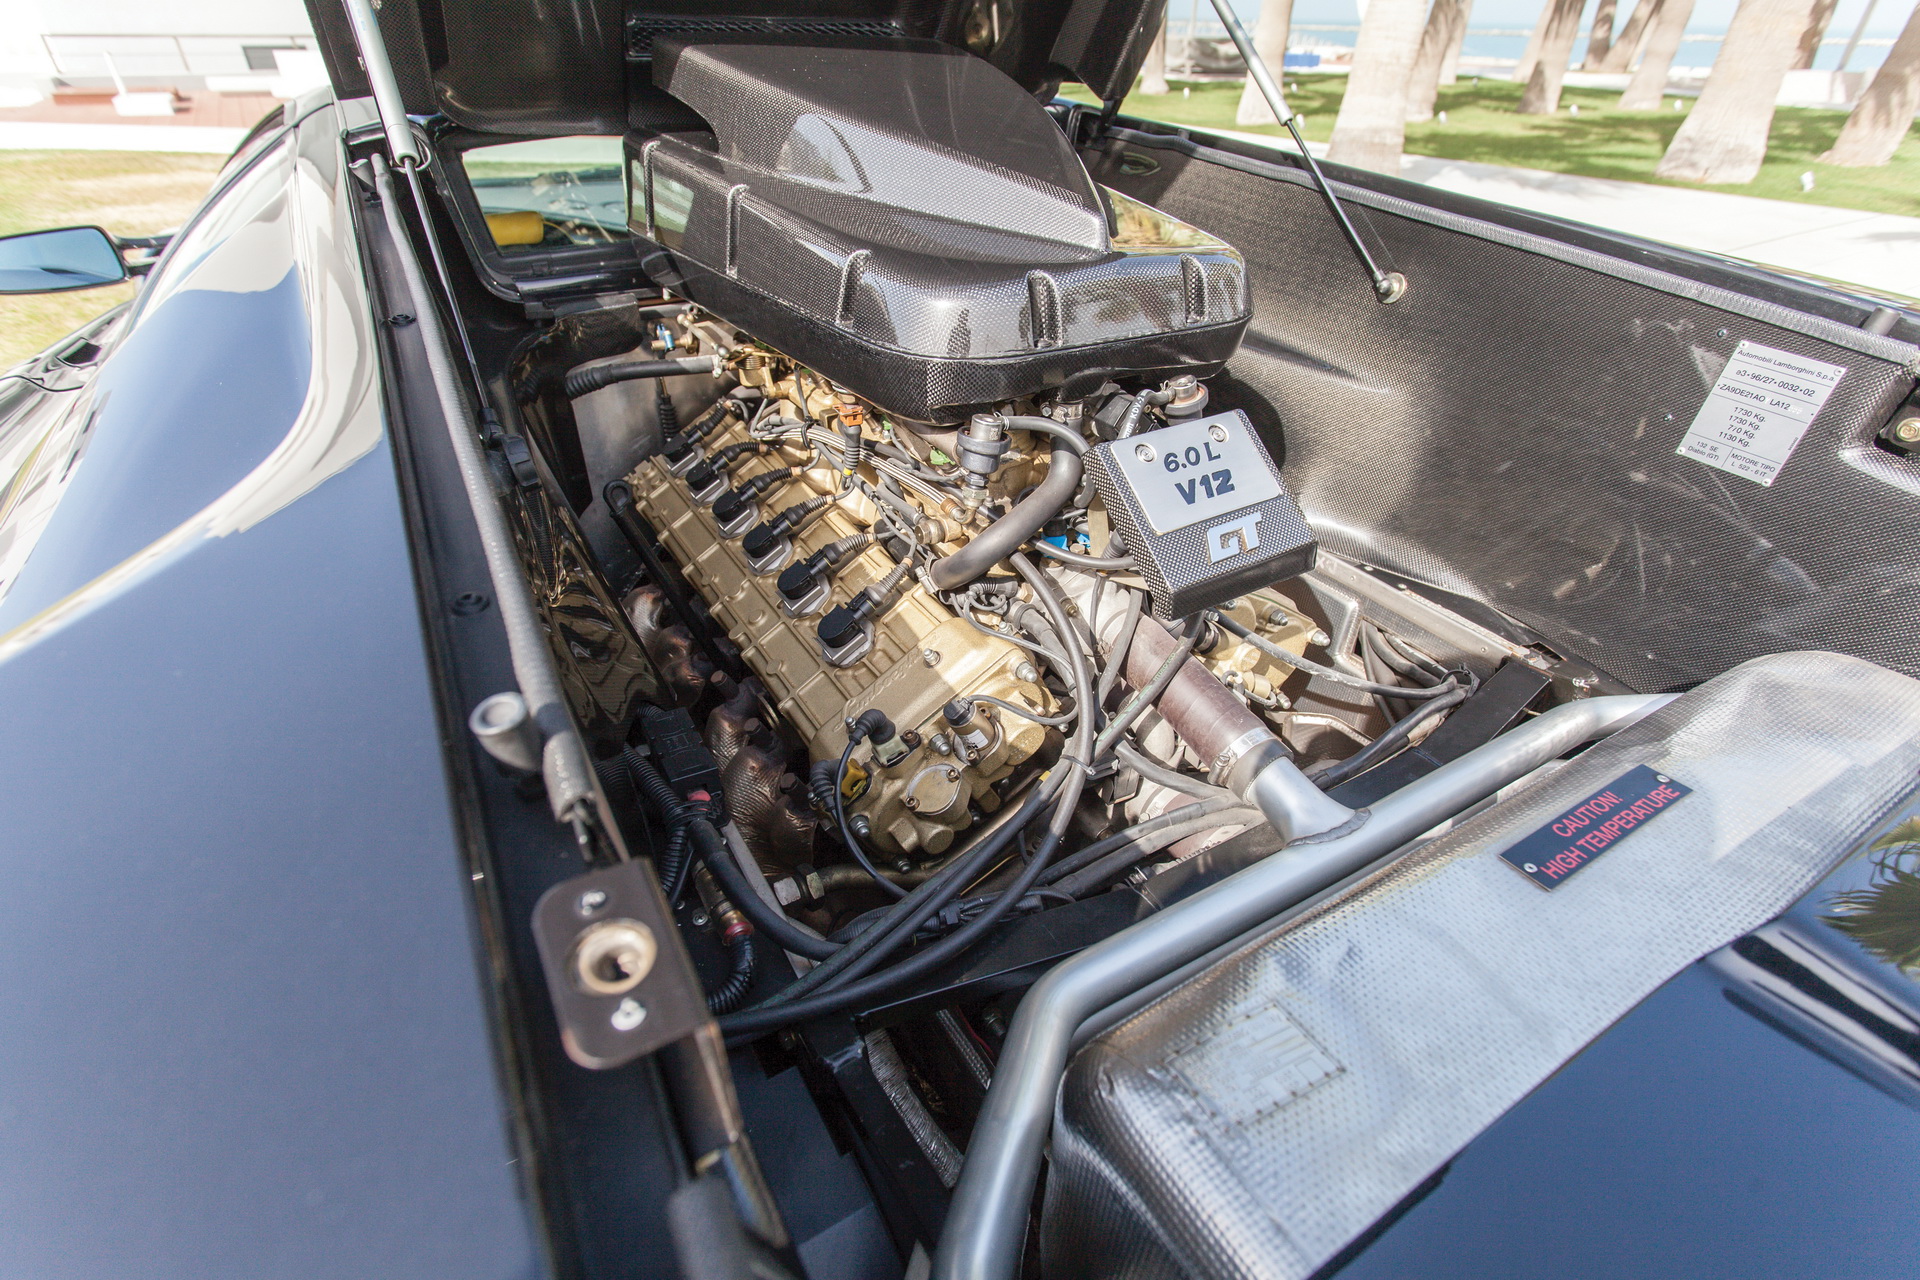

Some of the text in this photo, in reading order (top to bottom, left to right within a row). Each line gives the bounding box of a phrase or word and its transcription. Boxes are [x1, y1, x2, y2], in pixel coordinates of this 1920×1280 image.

[1737, 349, 1835, 382] Automobili Lamborghini S.p.a.
[1130, 396, 1145, 420] KDV-2
[1734, 406, 1766, 423] 1730 Kg.
[1729, 414, 1761, 431] 1730 Kg.
[1718, 431, 1750, 448] 1130 Kg.
[1742, 428, 1756, 440] Kg.
[1163, 441, 1221, 473] 6.0 L
[1687, 445, 1720, 461] Diablo (GT)
[1696, 440, 1719, 453] 132 SE
[1731, 452, 1776, 473] MOTORE TIPO
[1738, 463, 1750, 471] 522
[1174, 468, 1236, 505] V12
[1206, 511, 1262, 565] GT
[1552, 790, 1624, 837] CAUTION!
[1539, 784, 1681, 879] HIGH TEMPERATURE
